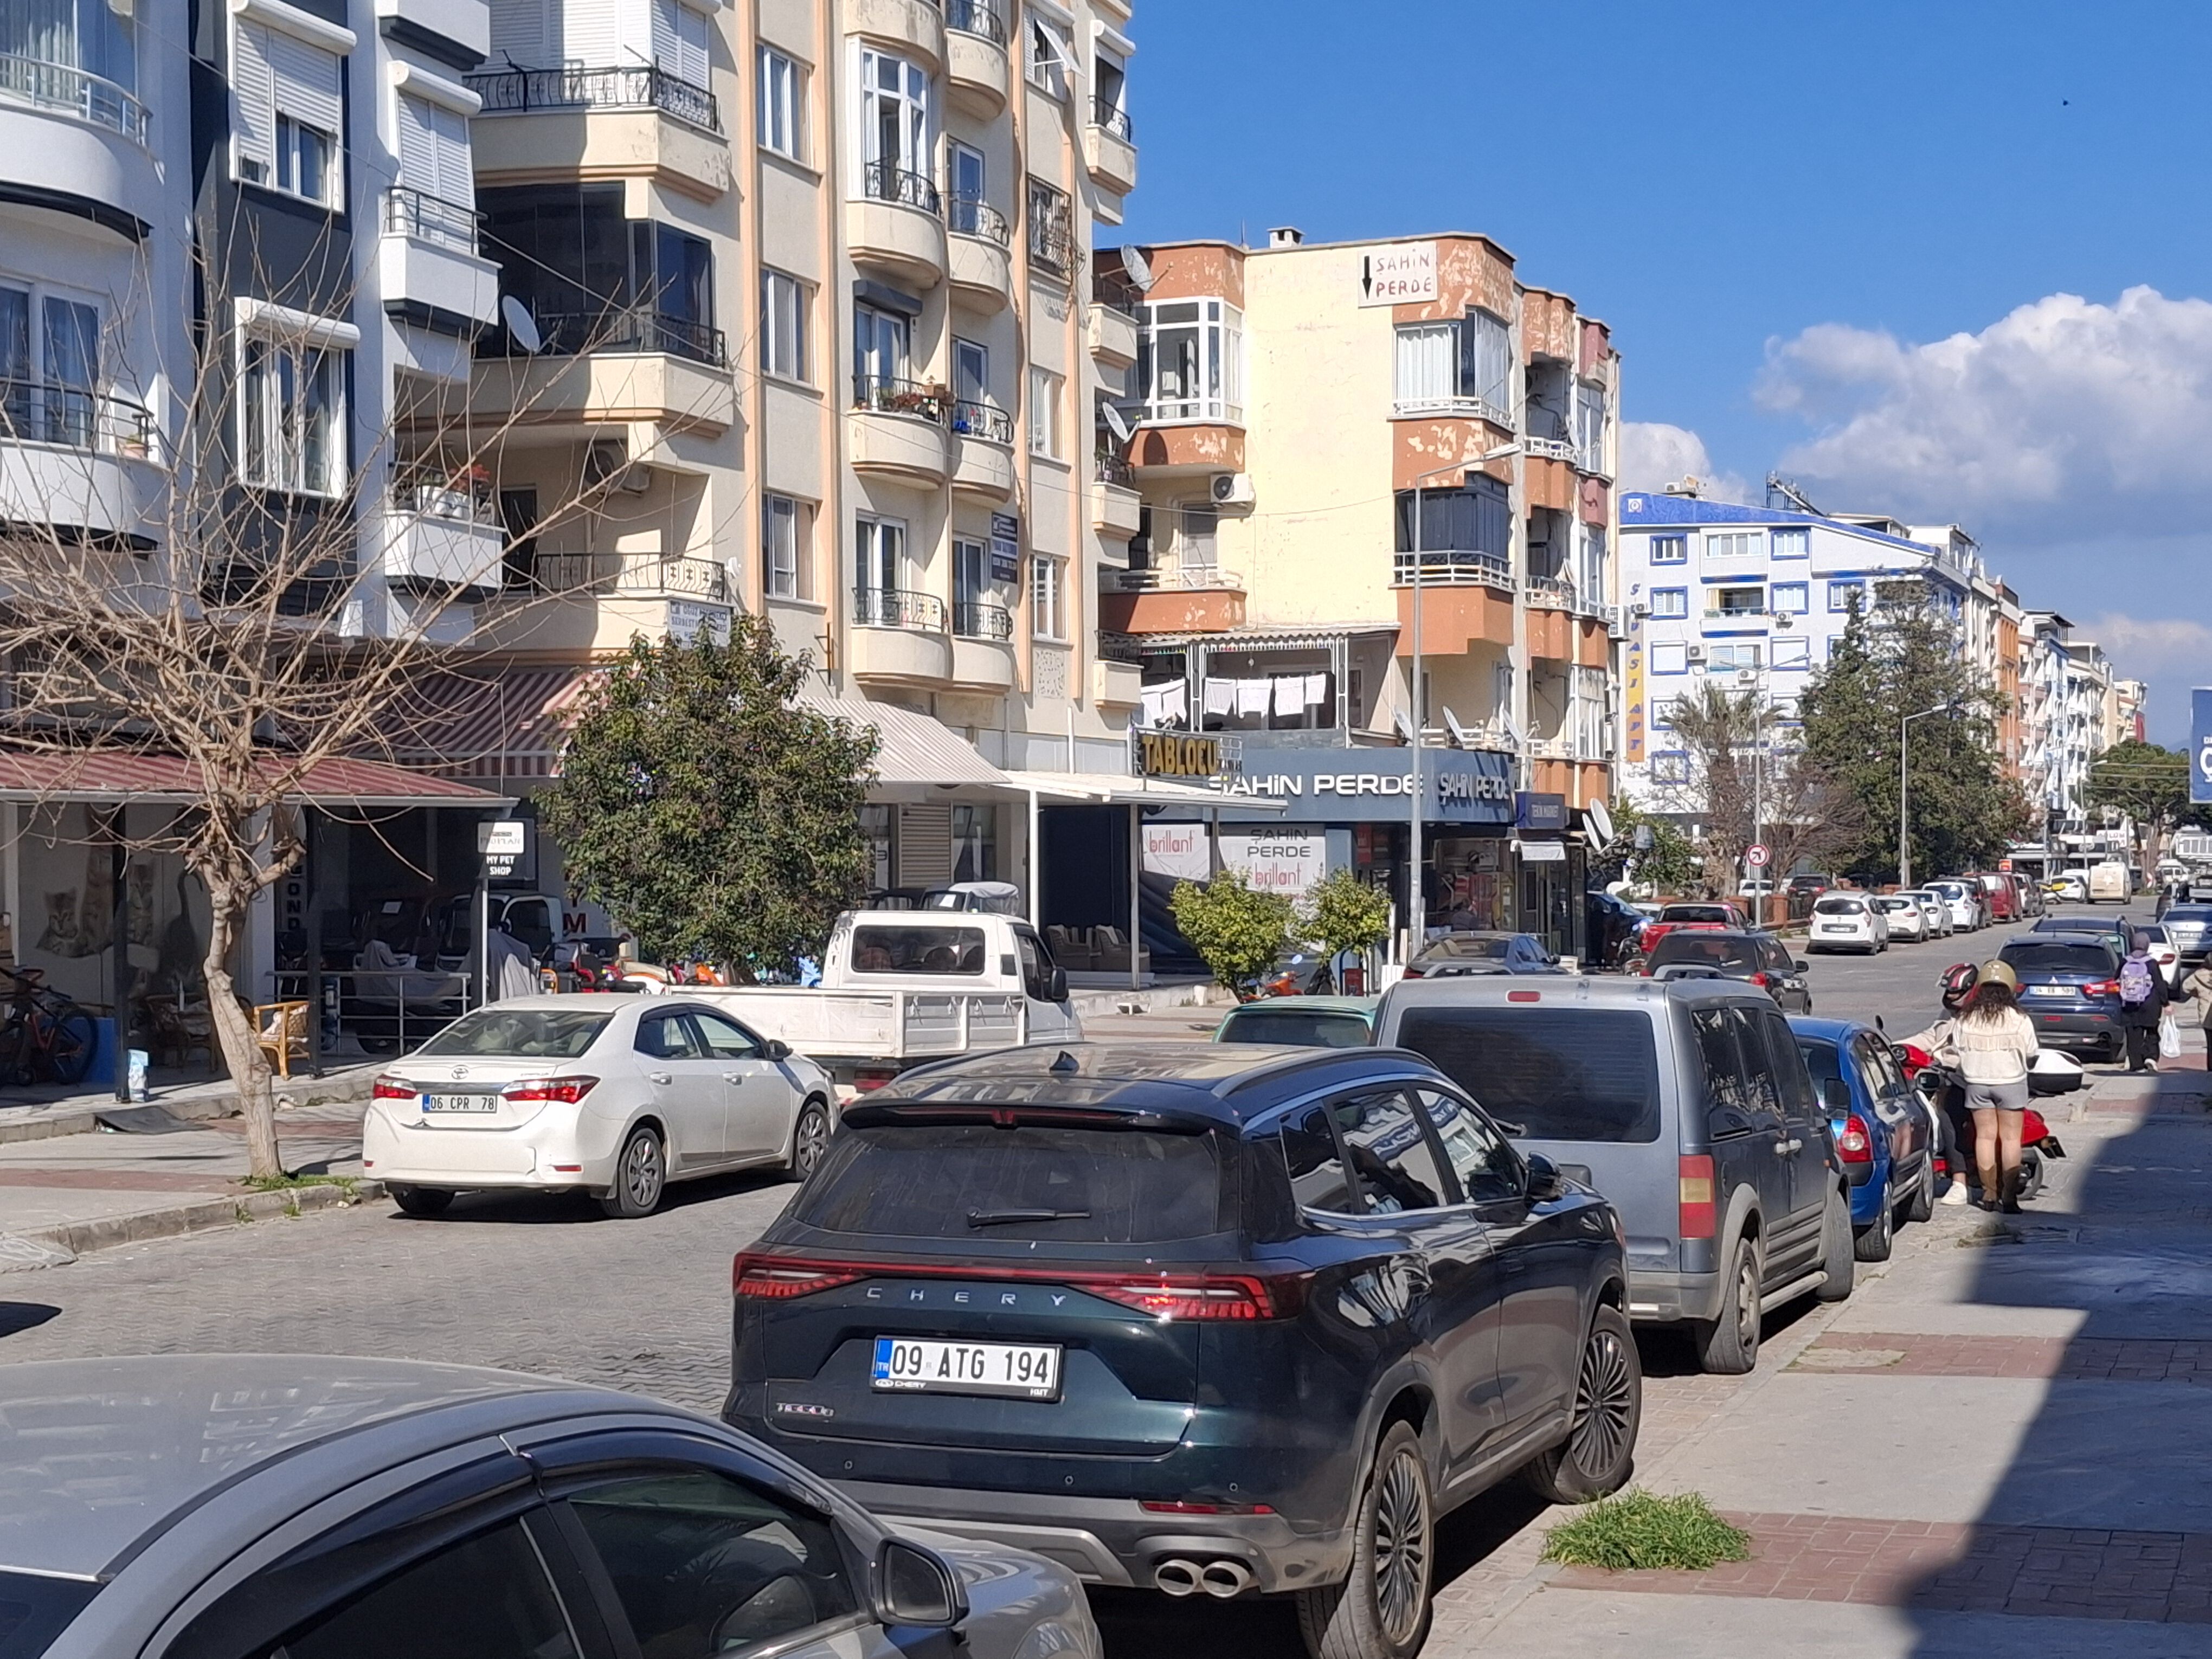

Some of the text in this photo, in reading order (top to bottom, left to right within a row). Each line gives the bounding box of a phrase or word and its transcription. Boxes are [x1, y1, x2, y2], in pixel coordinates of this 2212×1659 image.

[1376, 277, 1431, 298] PERDE
[1314, 774, 1423, 796] PERDE
[1476, 775, 1509, 799] PERDE
[1149, 830, 1194, 853] brillant
[1248, 846, 1310, 857] PERDE
[486, 855, 515, 865] MY PET
[490, 866, 512, 876] SHOP
[1255, 861, 1301, 885] brillant
[431, 1097, 494, 1110] 06 CPR 78
[867, 1287, 1066, 1306] CHERY
[878, 1361, 889, 1372] TR
[892, 1345, 1049, 1383] 09 ATG 194
